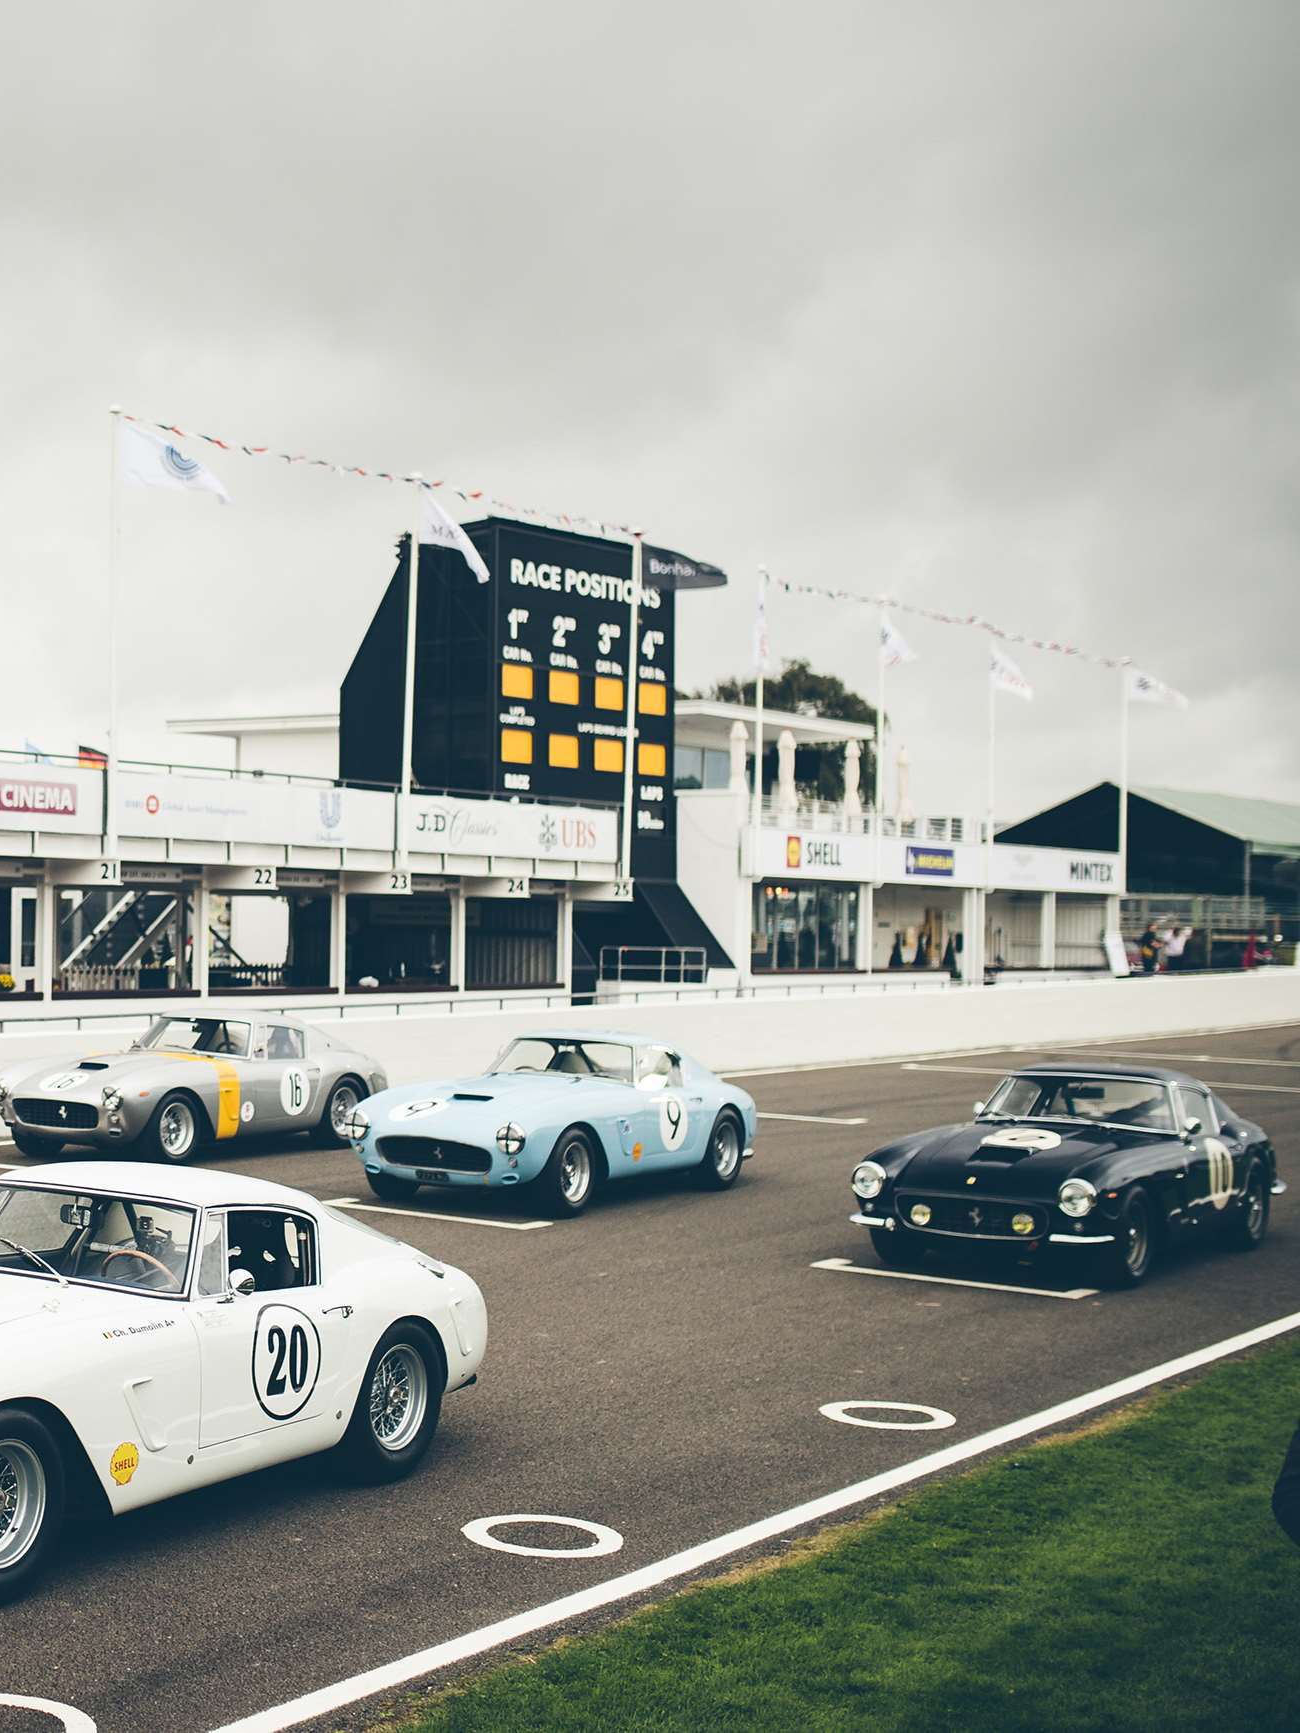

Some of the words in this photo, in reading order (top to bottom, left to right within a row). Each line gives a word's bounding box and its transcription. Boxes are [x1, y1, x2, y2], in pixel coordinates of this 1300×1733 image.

[510, 558, 562, 591] RACE
[564, 568, 661, 609] POSITIONS
[1, 784, 74, 812] CINEMA
[416, 813, 446, 832] J.D
[561, 816, 597, 849] UBS
[807, 842, 842, 866] SHELL
[101, 863, 117, 880] 21
[254, 868, 272, 884] 22
[391, 874, 408, 889] 23
[1070, 862, 1114, 882] MINTEX
[508, 879, 524, 893] 24
[614, 882, 629, 896] 25
[289, 1073, 302, 1108] 16
[667, 1100, 681, 1140] 9
[266, 1324, 308, 1396] 20
[114, 1456, 135, 1473] SHELL
